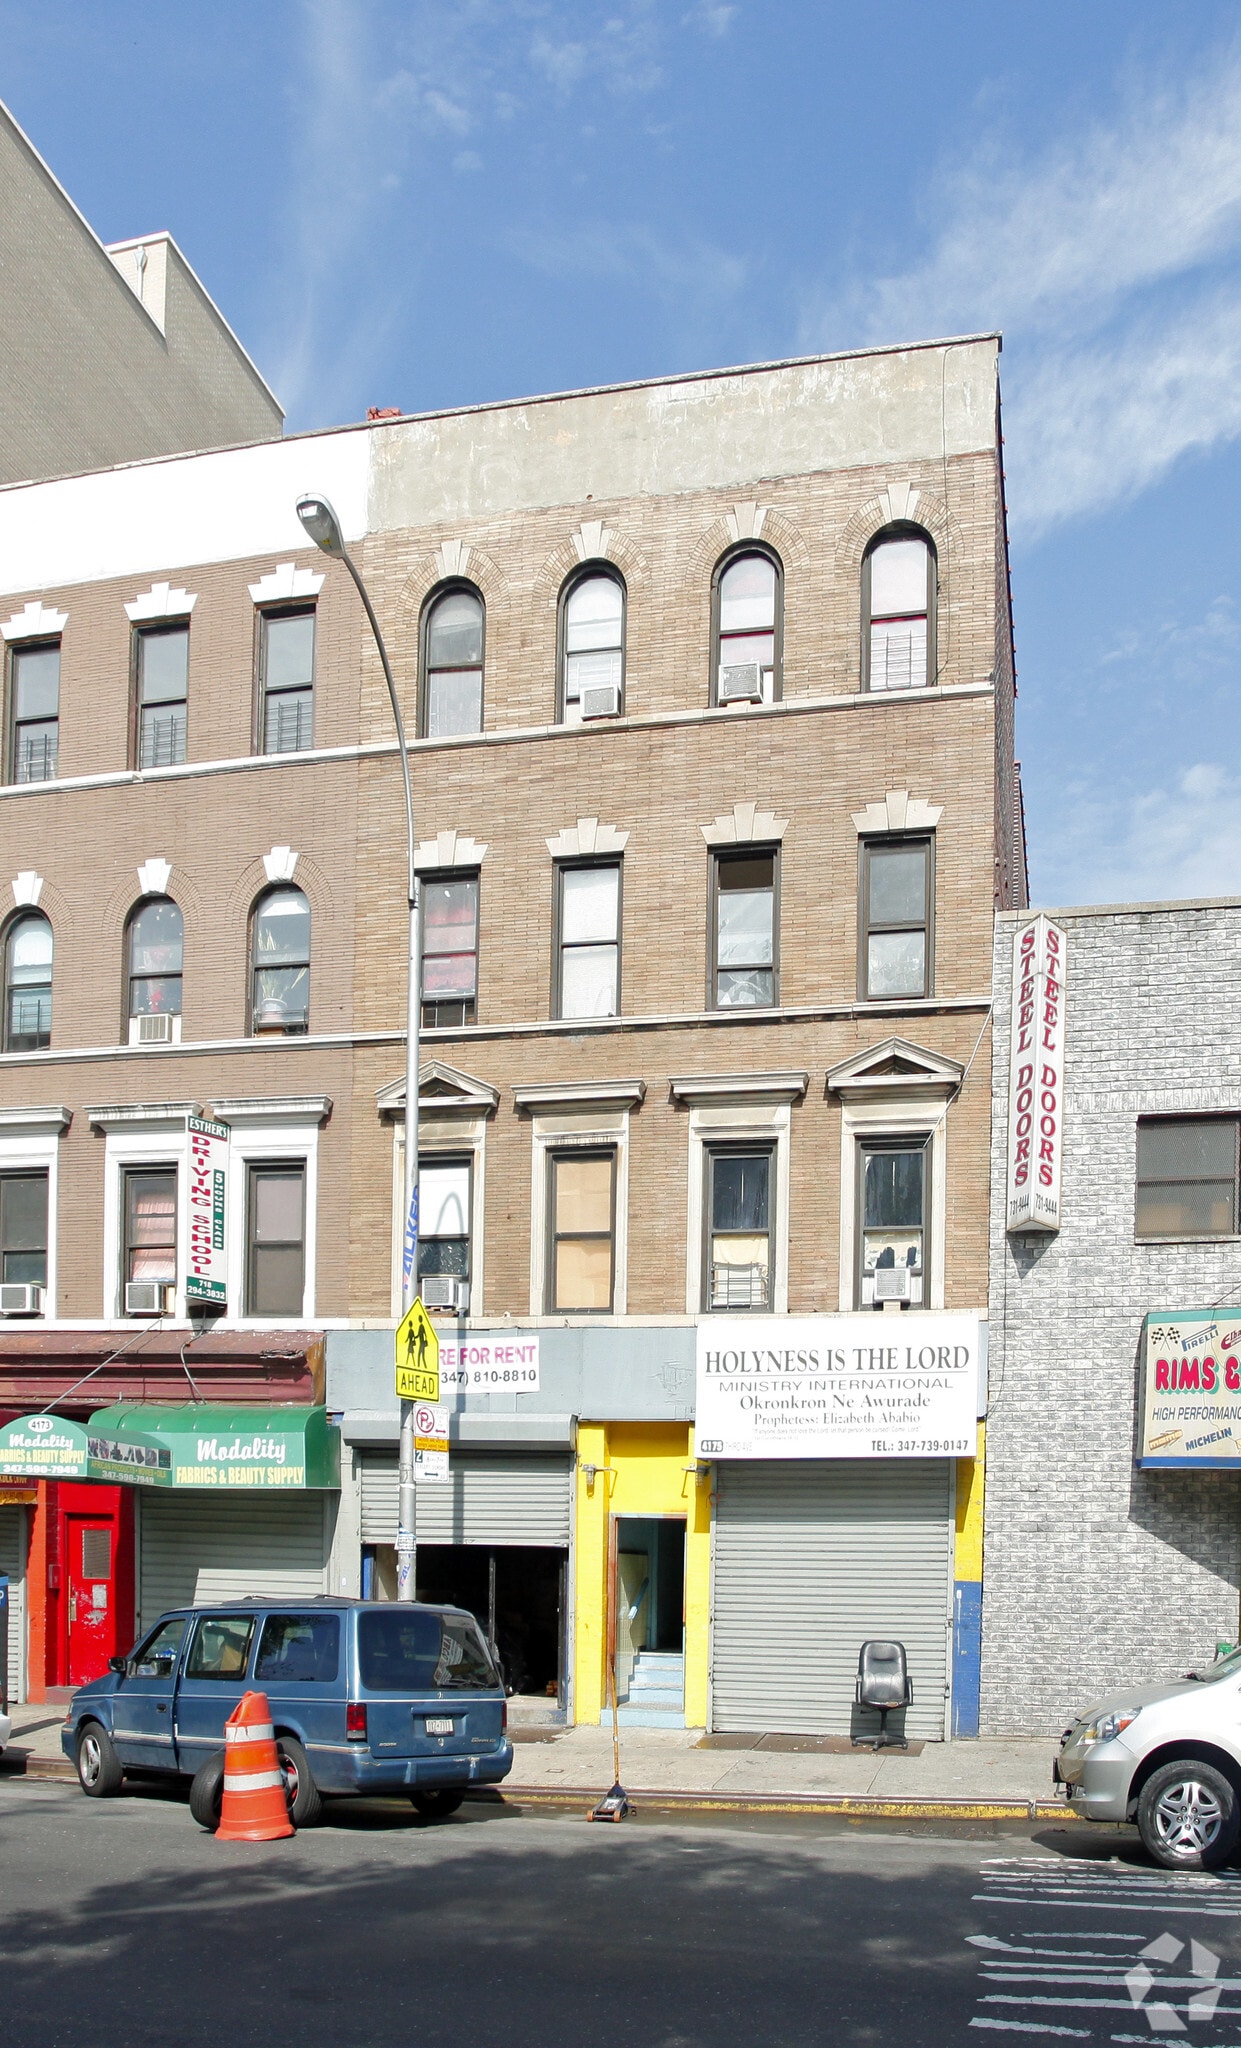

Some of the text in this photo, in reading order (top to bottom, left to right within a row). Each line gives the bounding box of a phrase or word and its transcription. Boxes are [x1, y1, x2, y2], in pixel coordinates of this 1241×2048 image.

[1014, 926, 1035, 1188] STEEL DOORS
[1038, 928, 1060, 1187] STEEL DOORS
[190, 1117, 227, 1137] ESTHER'S
[191, 1136, 212, 1275] DRIVING SCHOOL
[199, 1279, 212, 1288] 718
[1181, 1325, 1219, 1352] PIRELLI
[460, 1347, 490, 1365] FOR
[494, 1345, 536, 1364] RENT
[705, 1346, 969, 1373] HOLYNESS IS THE LORD
[473, 1369, 537, 1383] 810-8810
[1156, 1355, 1241, 1392] RIMS &
[401, 1372, 435, 1394] AHEAD
[720, 1378, 953, 1392] MINISTRY INTERNATIONAL
[740, 1393, 931, 1410] Okronkron Ne Awurade
[754, 1411, 921, 1427] Prophetess: Elizabeth Ababio
[1152, 1407, 1176, 1420] HIGH
[31, 1420, 51, 1429] 4173
[9, 1433, 74, 1450] Modality
[898, 1440, 968, 1451] 347-739-0147
[1185, 1427, 1232, 1451] MICHELIN
[26, 1451, 32, 1463] &
[33, 1450, 58, 1464] BEAUTY
[60, 1450, 85, 1464] SUPPLY
[197, 1437, 286, 1464] Modality
[3, 1464, 78, 1475] 347-590-7949
[102, 1470, 155, 1484] 347-590-7949
[176, 1466, 304, 1484] FABRICS & BEAUTY SUPPLY
